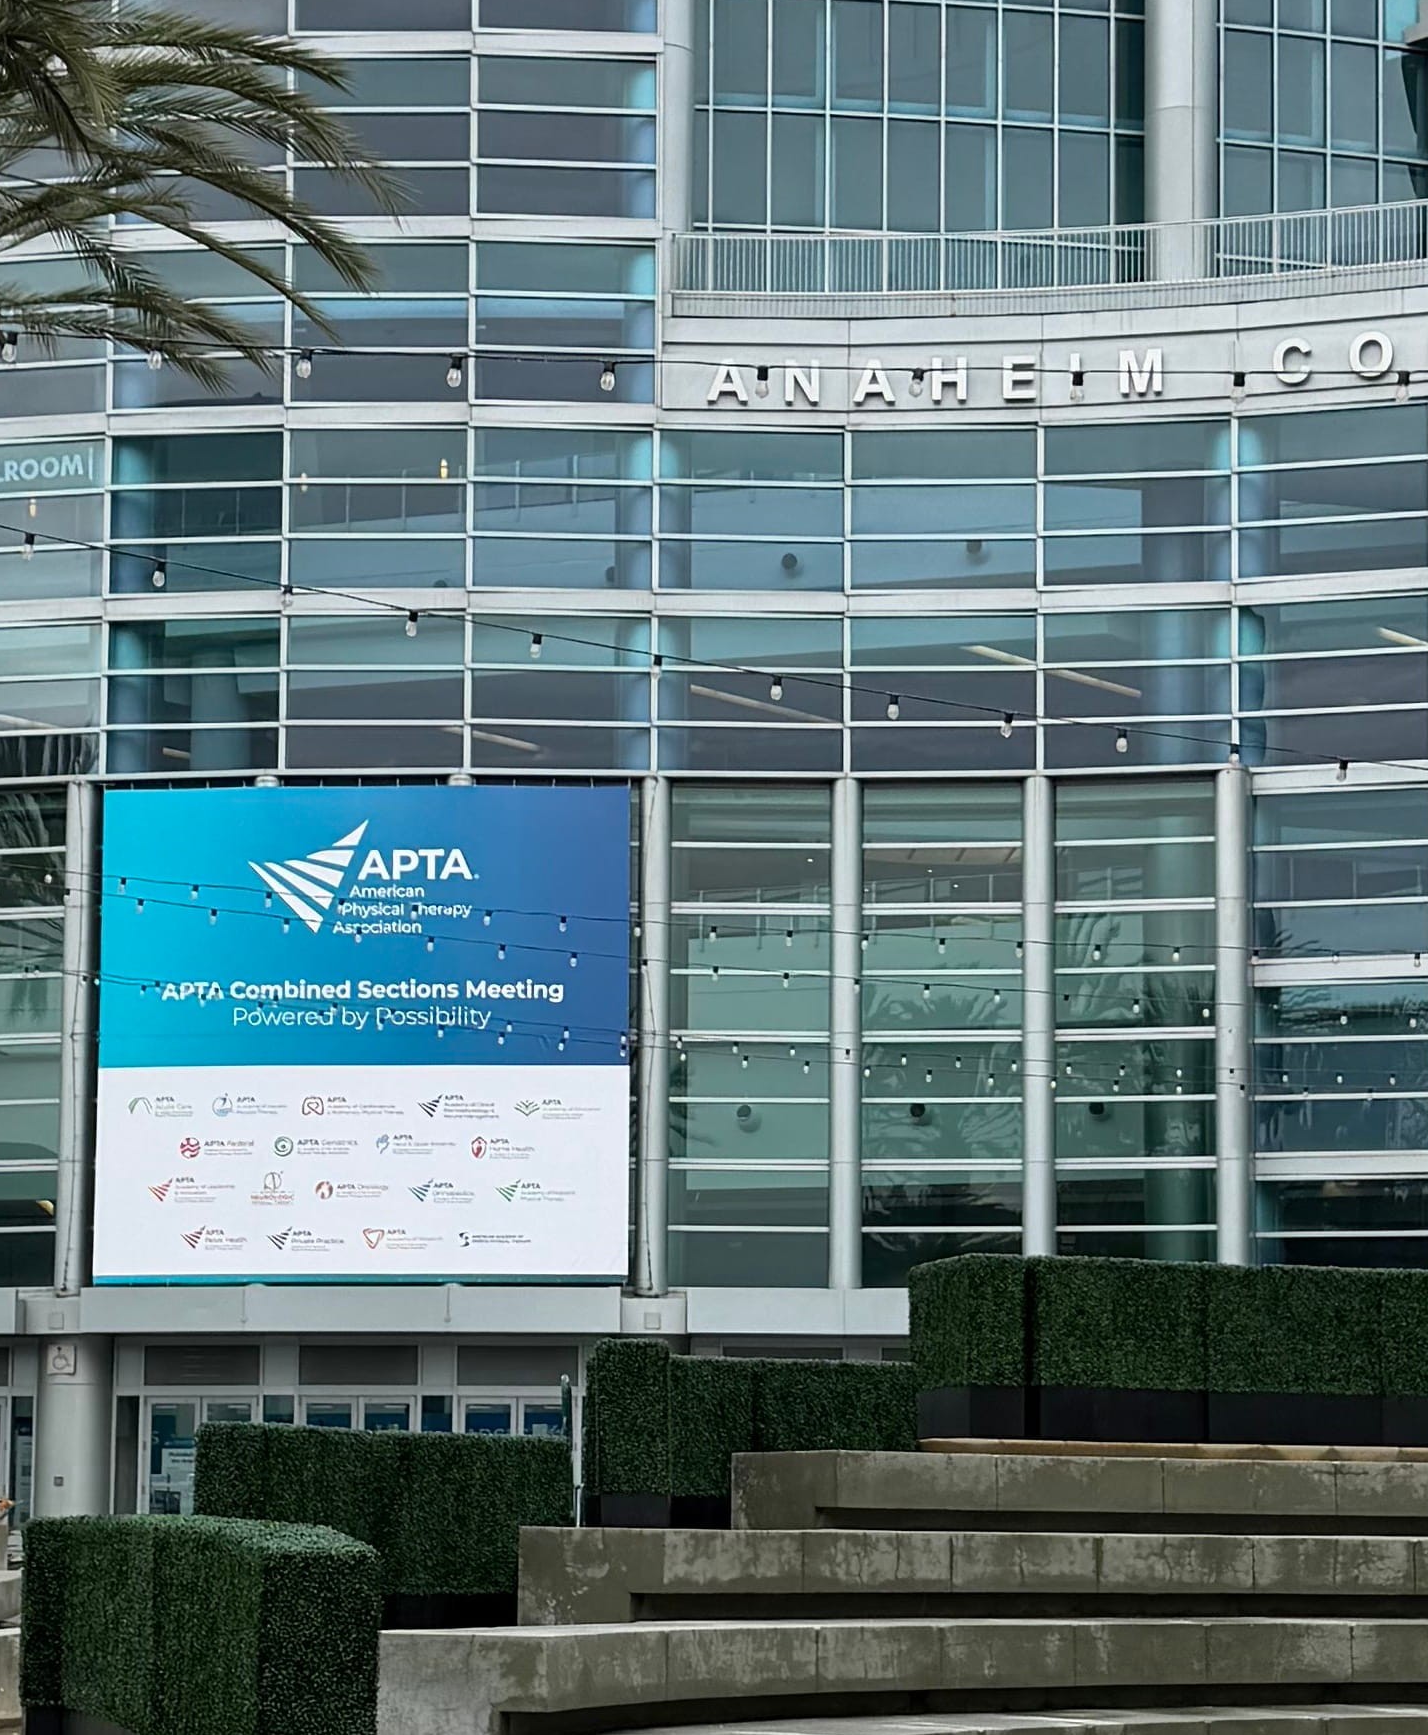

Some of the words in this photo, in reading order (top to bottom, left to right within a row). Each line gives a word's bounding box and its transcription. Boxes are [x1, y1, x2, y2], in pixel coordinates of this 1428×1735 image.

[707, 347, 1164, 406] ANAHEIM
[349, 884, 425, 898] American
[341, 903, 405, 919] Physical
[161, 981, 224, 1001] APTA
[230, 979, 351, 1000] Combined
[358, 978, 459, 999] Sections
[466, 979, 564, 1003] Meeting
[233, 1007, 334, 1027] Powered
[342, 1006, 369, 1030] by
[376, 1006, 492, 1029] Possibility
